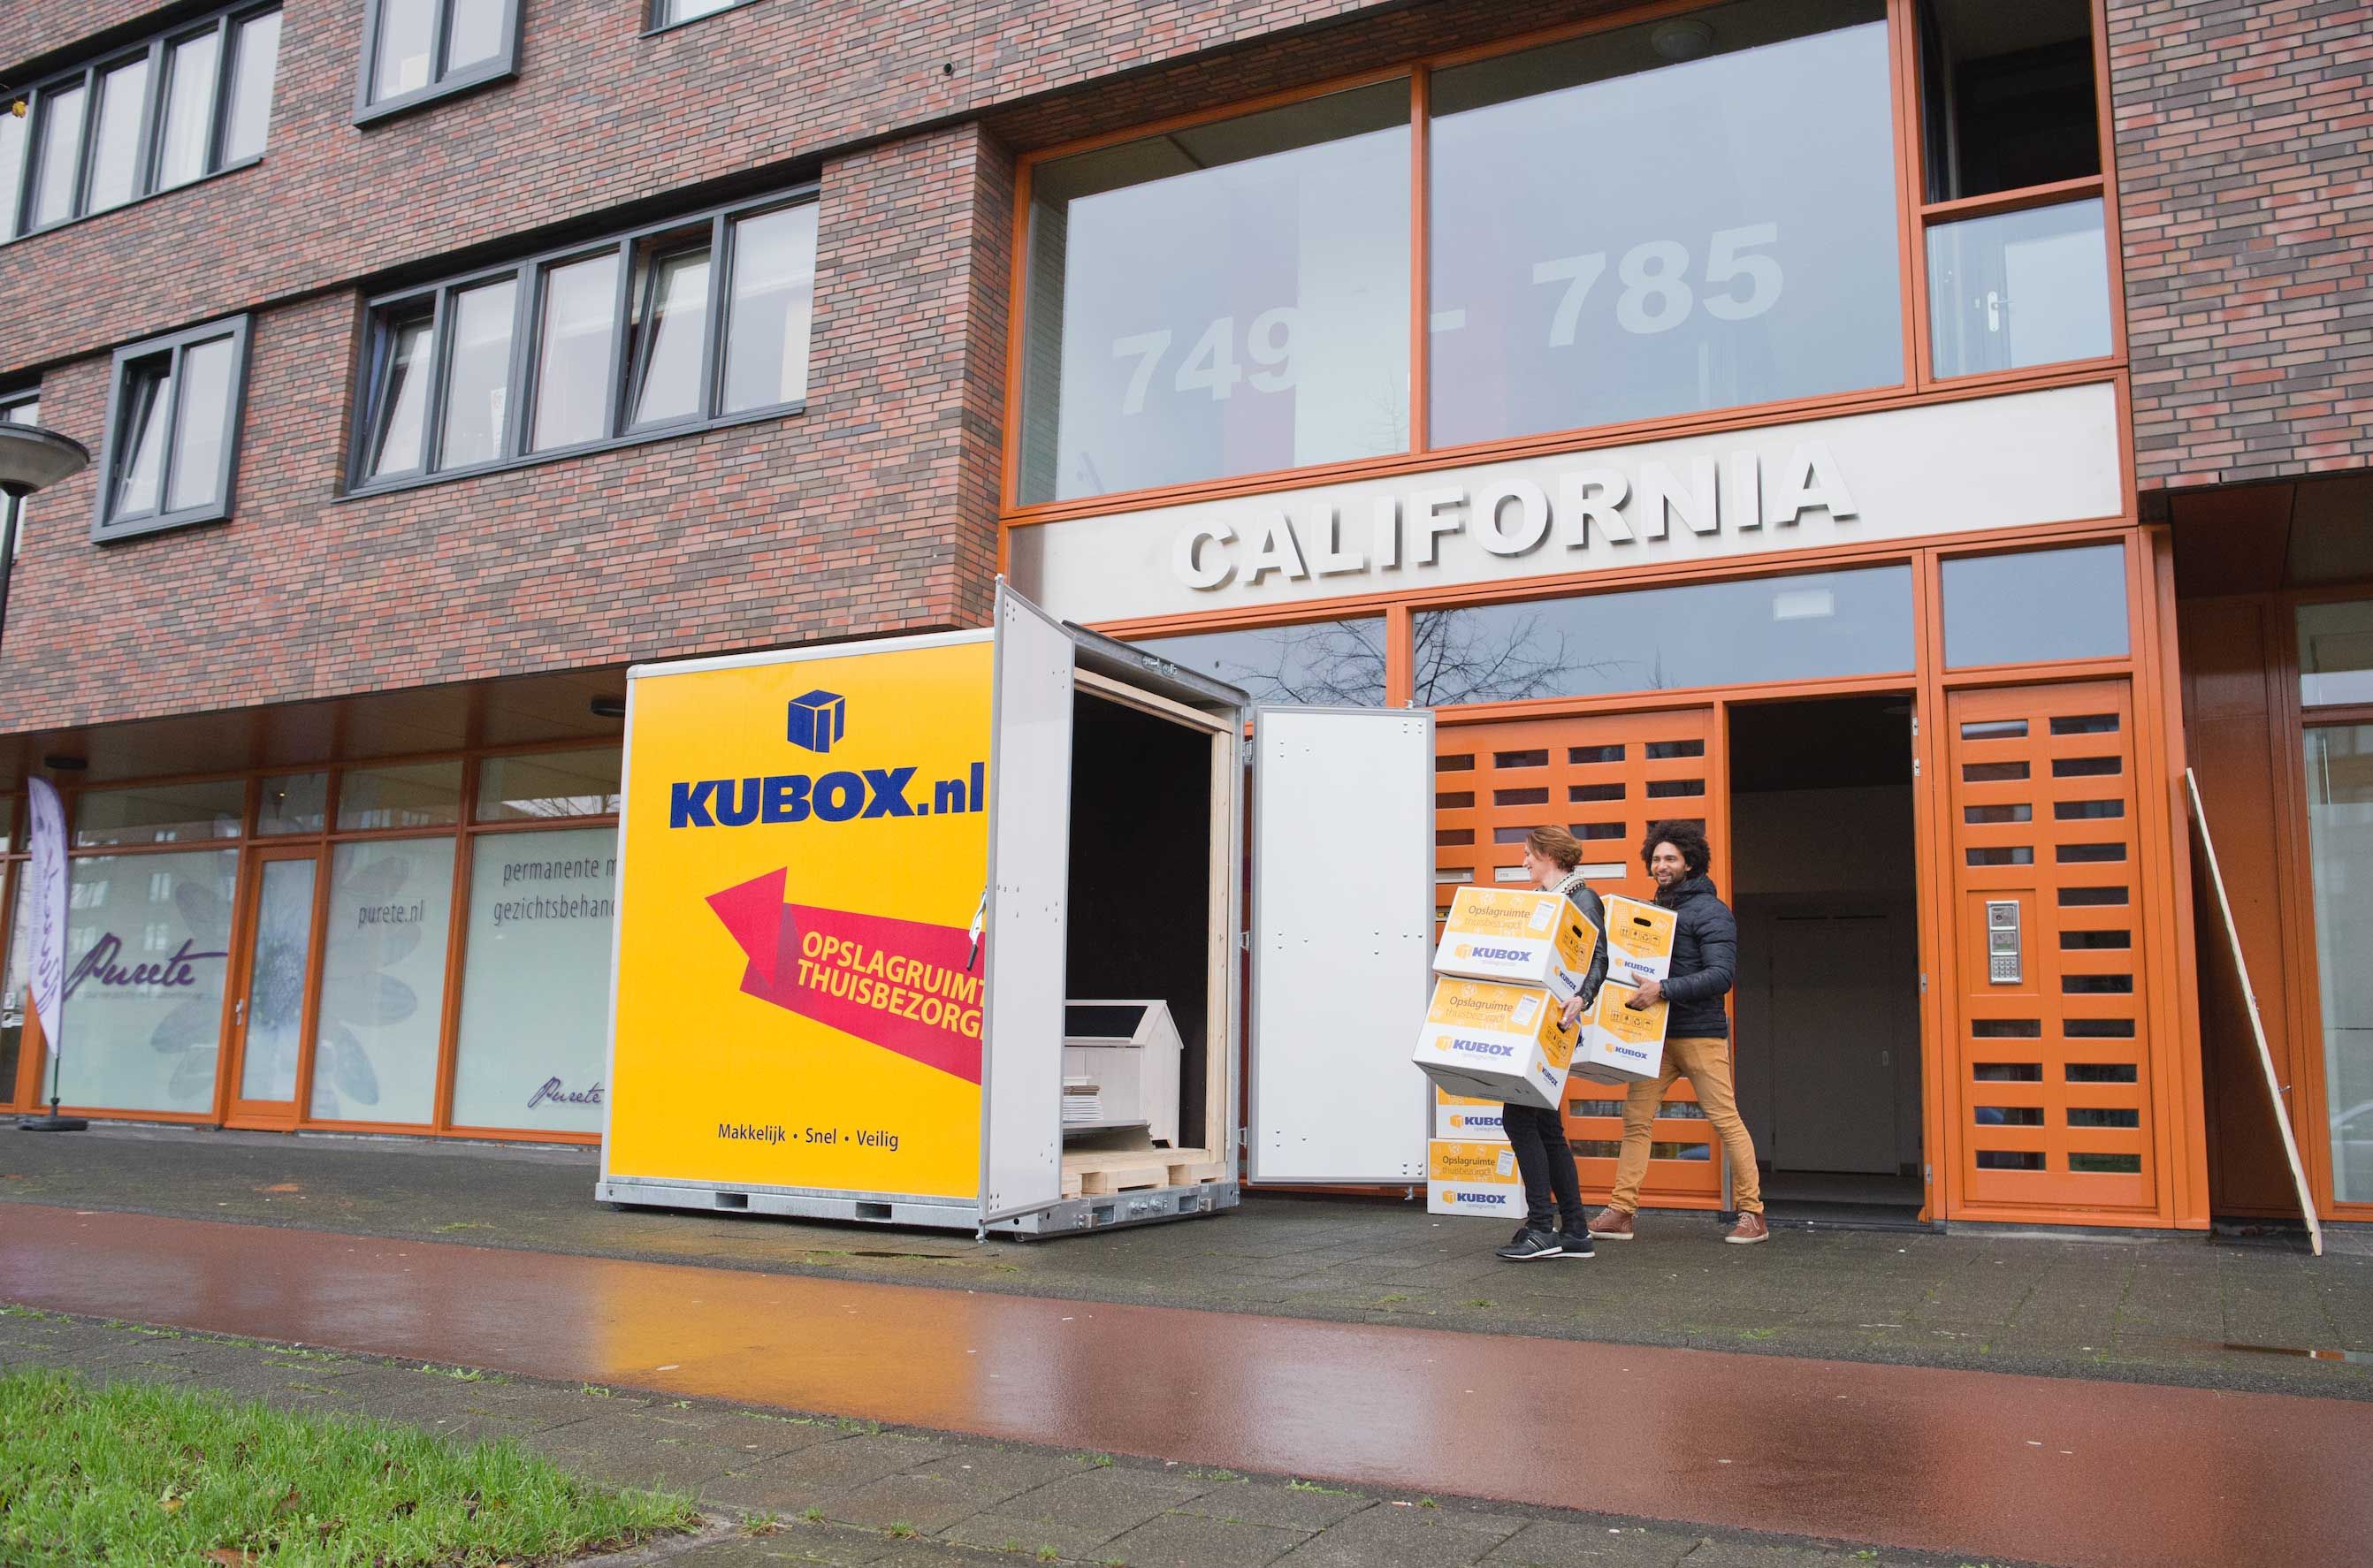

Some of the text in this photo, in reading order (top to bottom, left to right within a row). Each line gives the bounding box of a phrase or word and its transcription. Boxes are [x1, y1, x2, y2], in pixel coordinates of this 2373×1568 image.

[1111, 307, 1297, 417] 749
[1532, 221, 1784, 348] 785
[1172, 439, 1858, 591] CALIFORNIA
[668, 761, 985, 829] KUBOX.nl
[502, 857, 599, 887] permanente
[358, 898, 424, 929] purete.nl
[1468, 904, 1531, 920] Opslagruimte
[1471, 946, 1533, 963] KUBOX
[63, 932, 228, 1003] Purete
[1623, 960, 1656, 975] KUBOX
[1559, 970, 1577, 992] KUBOX
[797, 958, 984, 1040] THUISBEZORG
[1449, 996, 1514, 1013] Opslagruimte
[1453, 1039, 1515, 1057] KUBOX
[1614, 1046, 1648, 1060] KUBOX
[1541, 1066, 1559, 1087] KUBOX
[527, 1076, 605, 1108] Purete
[1464, 1116, 1503, 1126] KUBO
[717, 1123, 899, 1152] Makkelijk Snel Veilig
[1442, 1155, 1496, 1167] Opslagruimte
[1456, 1192, 1507, 1204] KUBOX
